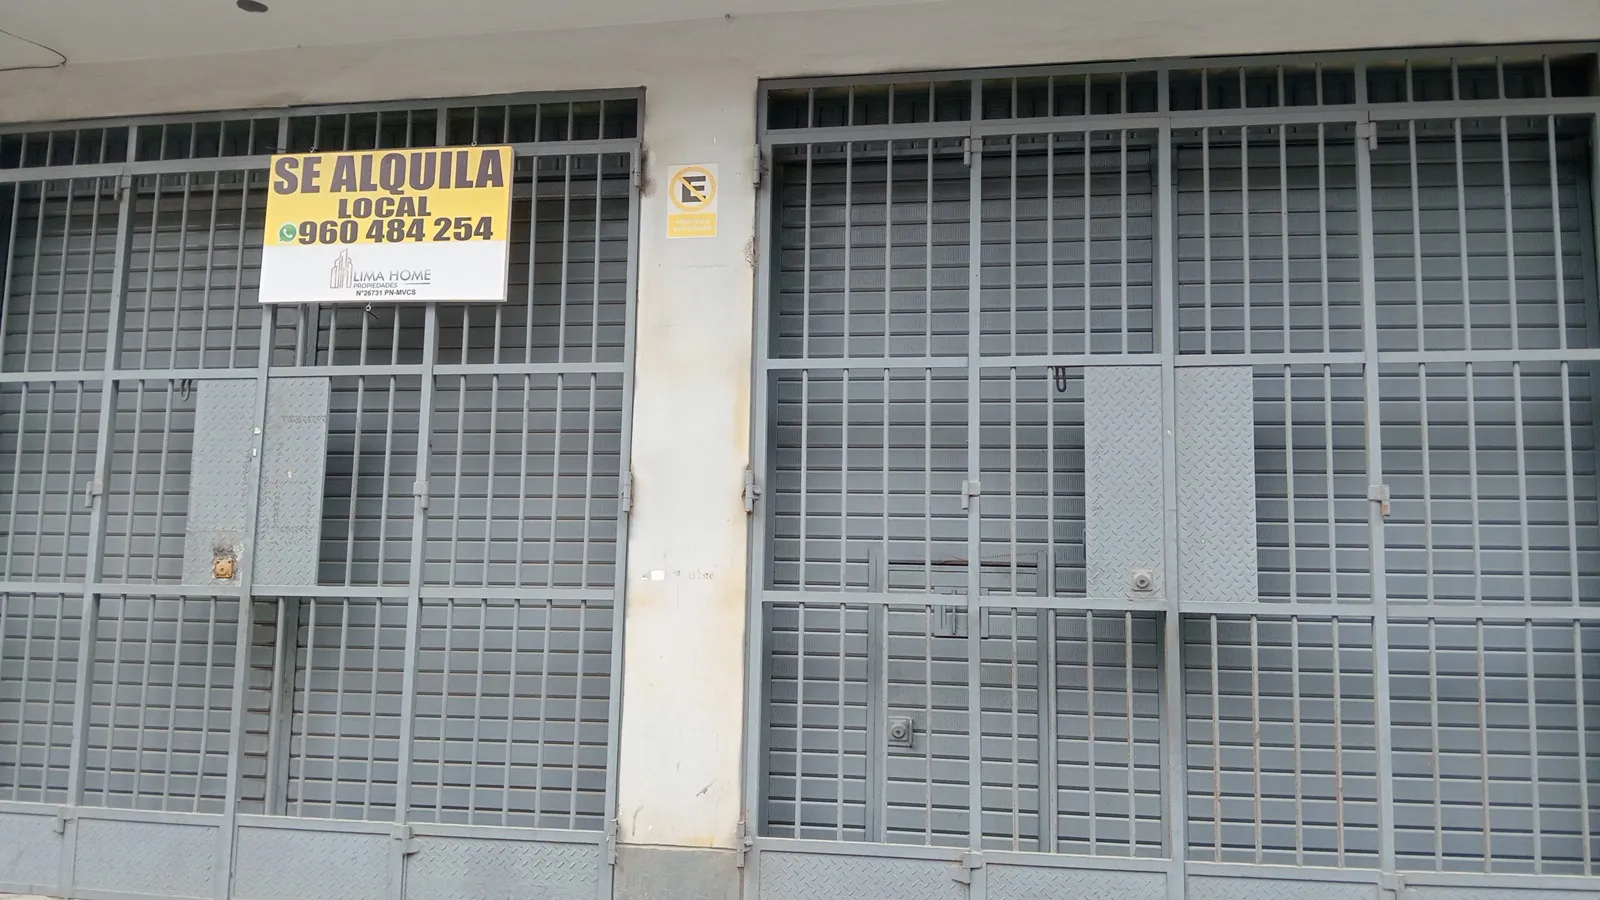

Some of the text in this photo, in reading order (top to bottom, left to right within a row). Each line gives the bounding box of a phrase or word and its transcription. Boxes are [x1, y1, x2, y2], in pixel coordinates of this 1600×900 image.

[273, 150, 504, 195] SE ALQUILA
[337, 196, 431, 219] LOCAL
[298, 216, 493, 244] 960 484 254
[353, 269, 431, 281] LIMA HOME
